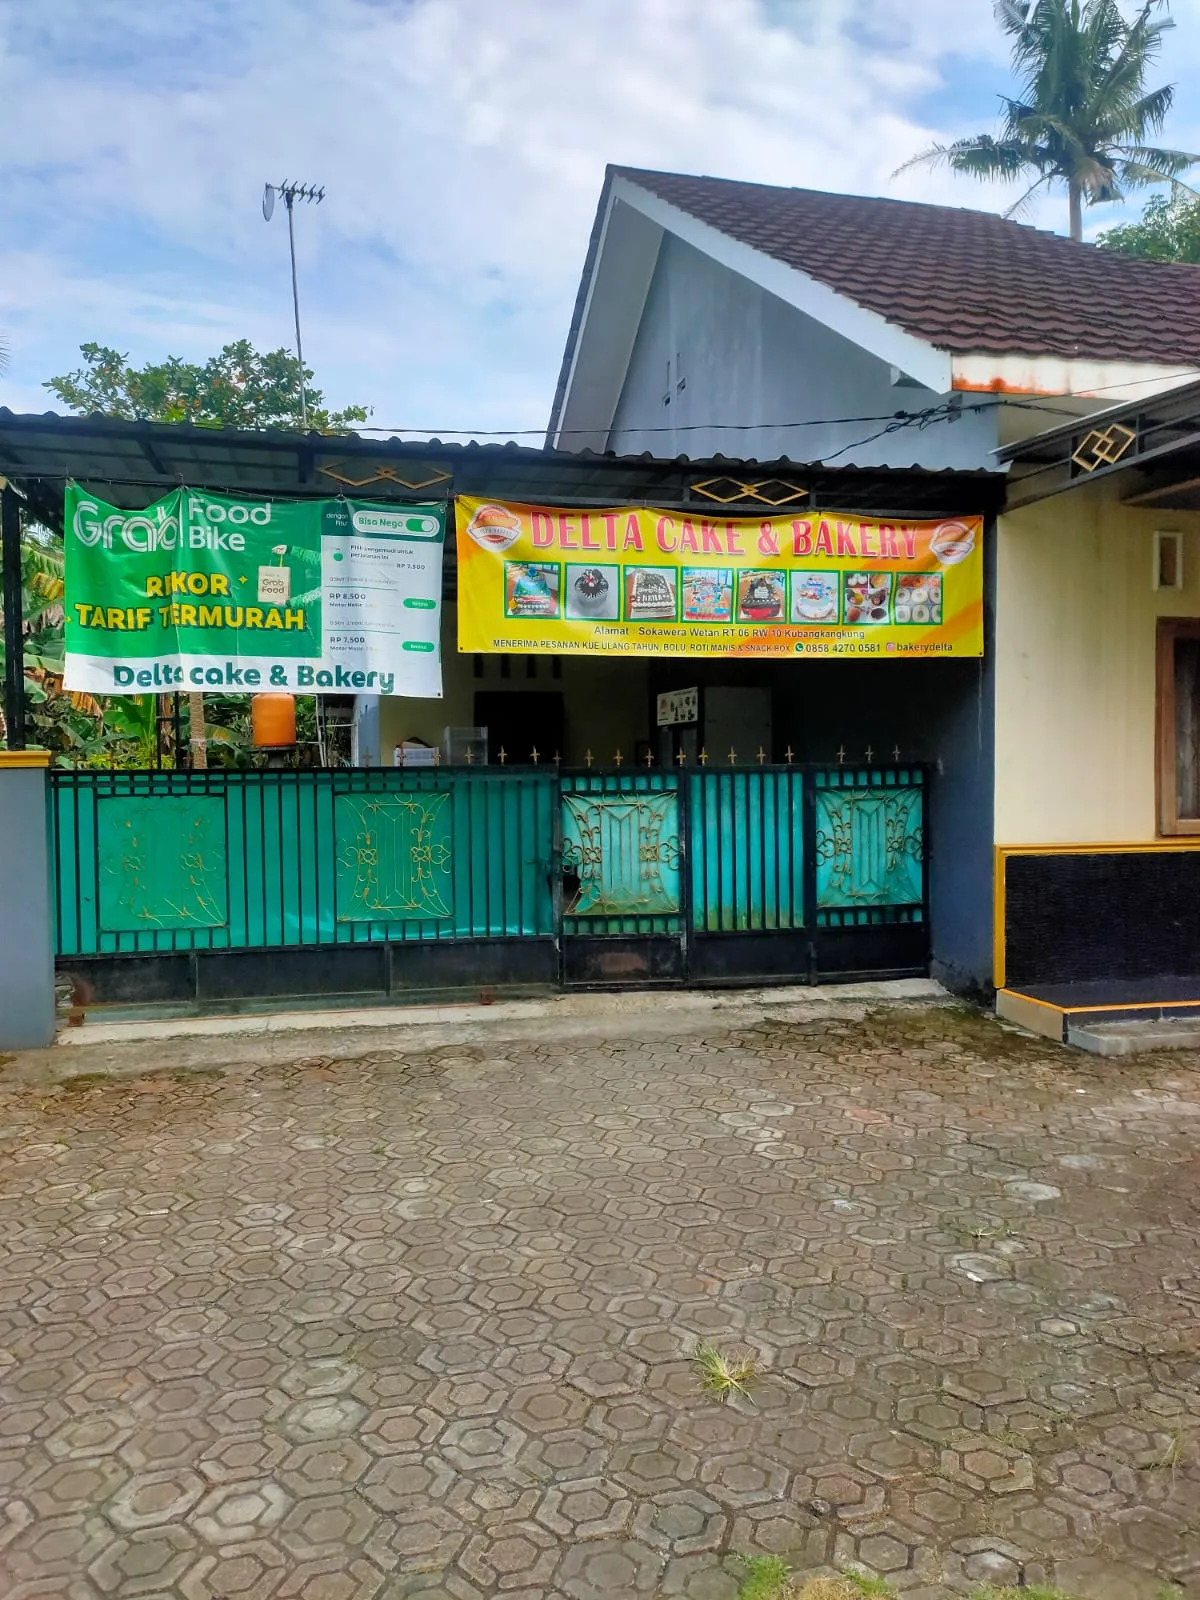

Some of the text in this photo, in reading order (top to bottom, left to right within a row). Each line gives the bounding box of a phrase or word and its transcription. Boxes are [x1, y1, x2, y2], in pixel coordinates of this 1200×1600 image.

[188, 498, 272, 526] Food
[358, 517, 404, 529] Bisa Nego
[73, 500, 179, 552] Grab
[189, 525, 246, 552] Bike
[530, 511, 917, 559] DELTA CAKE & BAKERY
[261, 585, 285, 594] Food
[262, 578, 285, 587] Grab
[75, 603, 304, 631] TARIF TERMURAH
[594, 625, 865, 640] Alamat Sokawera Wetan RT 06 RW 10 Kubangkangkung
[493, 639, 538, 648] MENERIMA
[540, 640, 580, 649] PESANAN
[582, 641, 600, 650] KUE
[601, 642, 630, 651] ULANG
[690, 643, 709, 651] ROTI
[710, 644, 736, 652] MANIS
[745, 644, 771, 652] SNACK
[805, 643, 829, 653] 0858
[832, 643, 855, 653] 4270
[858, 643, 881, 653] 0581
[897, 642, 953, 654] bakerydelta
[113, 662, 395, 695] Delta cake & Bakery
